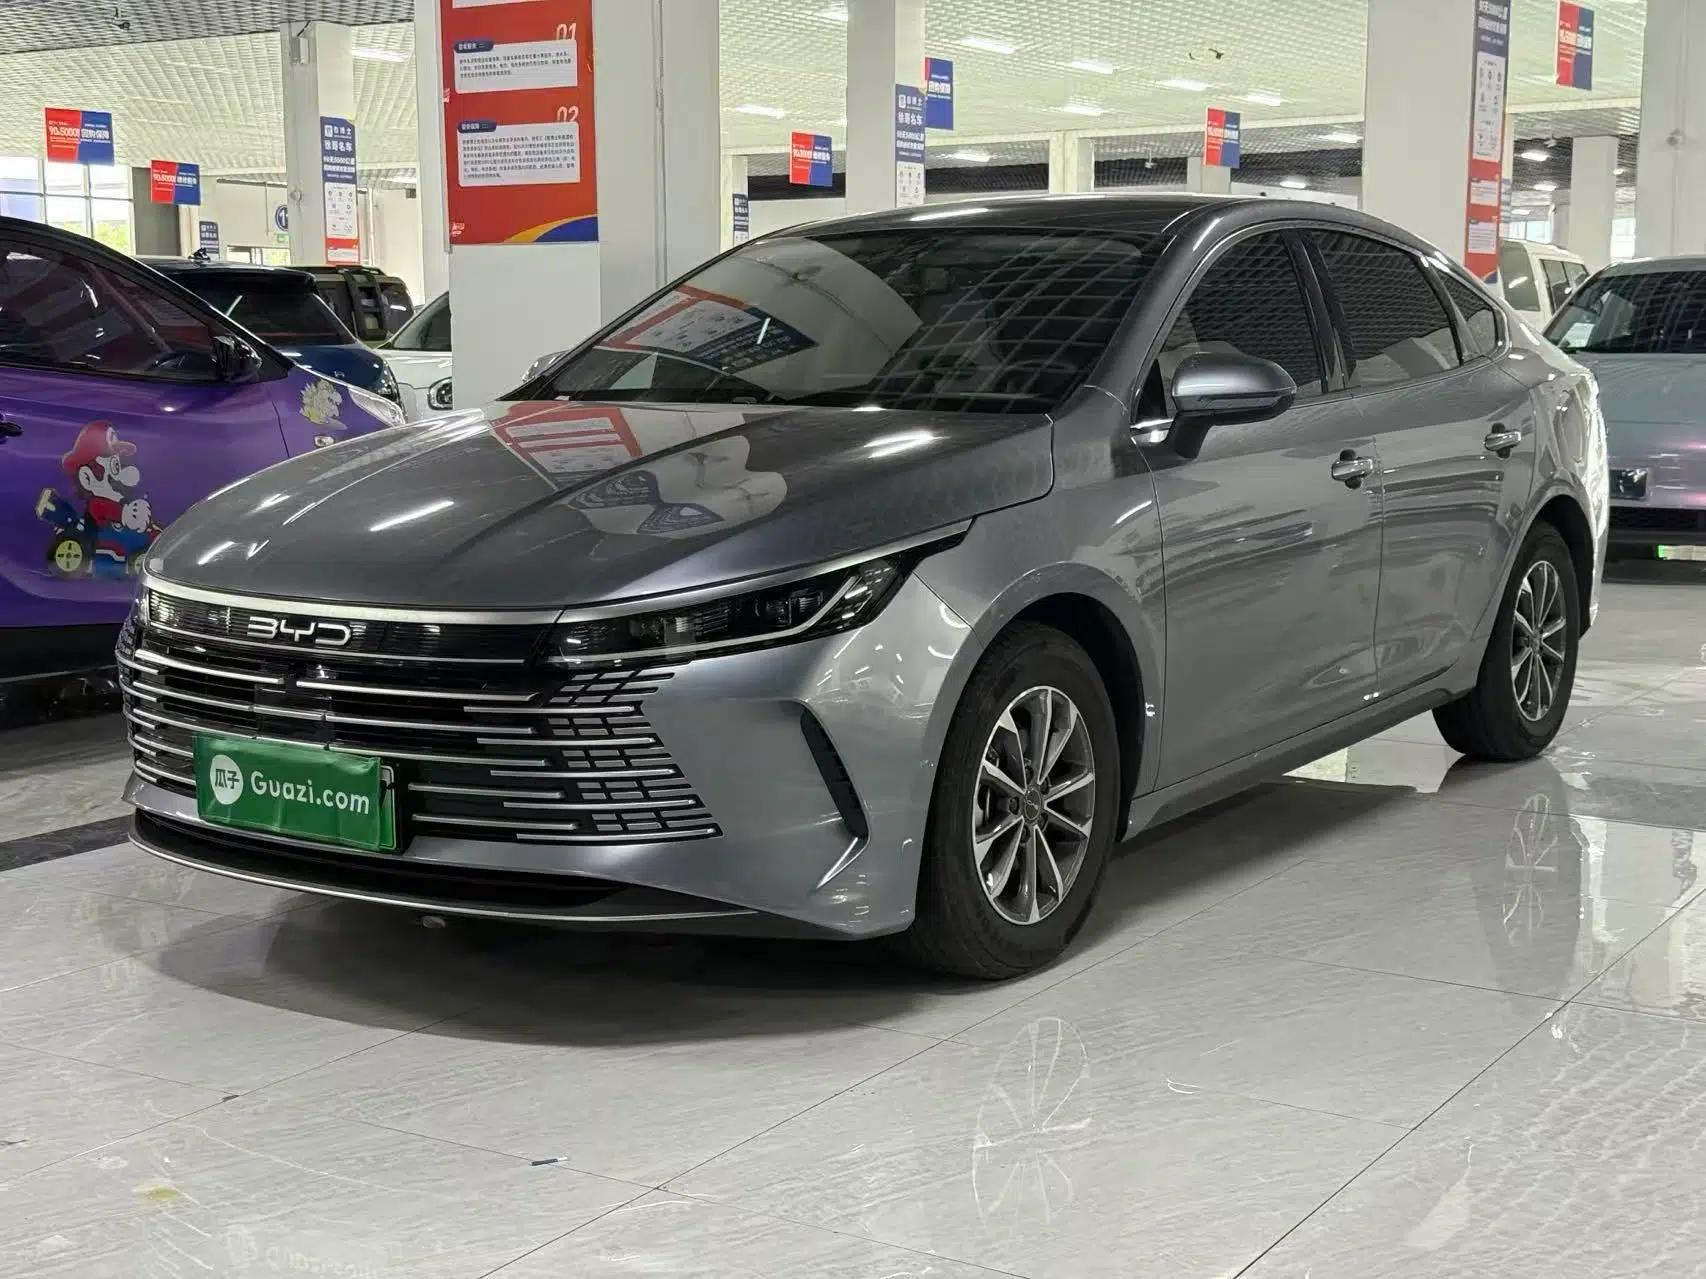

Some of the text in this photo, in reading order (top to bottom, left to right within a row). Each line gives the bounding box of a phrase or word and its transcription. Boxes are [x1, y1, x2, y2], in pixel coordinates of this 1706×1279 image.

[556, 22, 577, 41] 01
[556, 105, 579, 122] 02
[246, 616, 351, 646] BYD
[214, 768, 240, 790] 瓜子
[250, 770, 370, 815] Guazi.com
